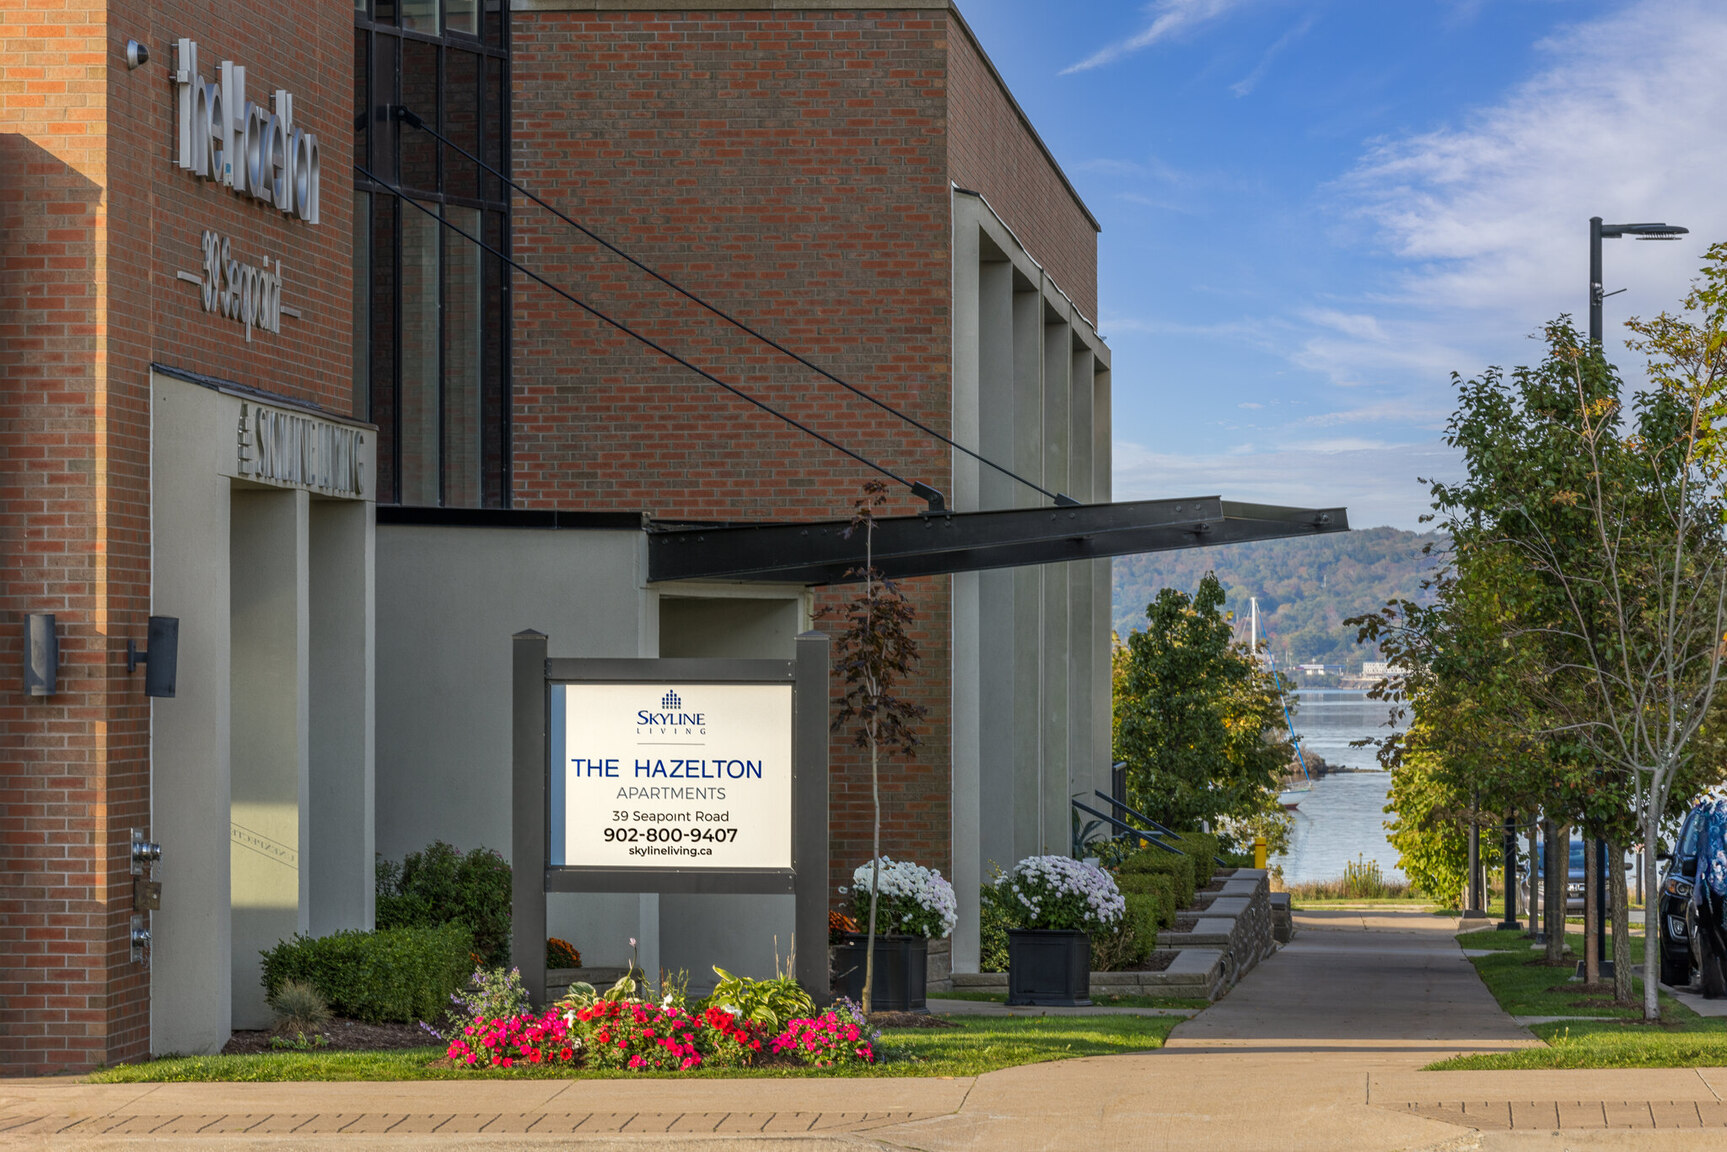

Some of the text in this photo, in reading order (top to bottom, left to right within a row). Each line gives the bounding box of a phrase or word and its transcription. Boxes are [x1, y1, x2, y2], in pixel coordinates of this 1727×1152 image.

[202, 229, 282, 342] 39 Seapoint
[636, 727, 706, 735] LIVING
[571, 758, 763, 779] THE HAZELTON
[616, 786, 726, 800] APARTMENTS
[612, 810, 729, 824] 39 Seapoint Road
[603, 827, 738, 843] 902-800-9407
[628, 845, 713, 857] skylineliving.ca
